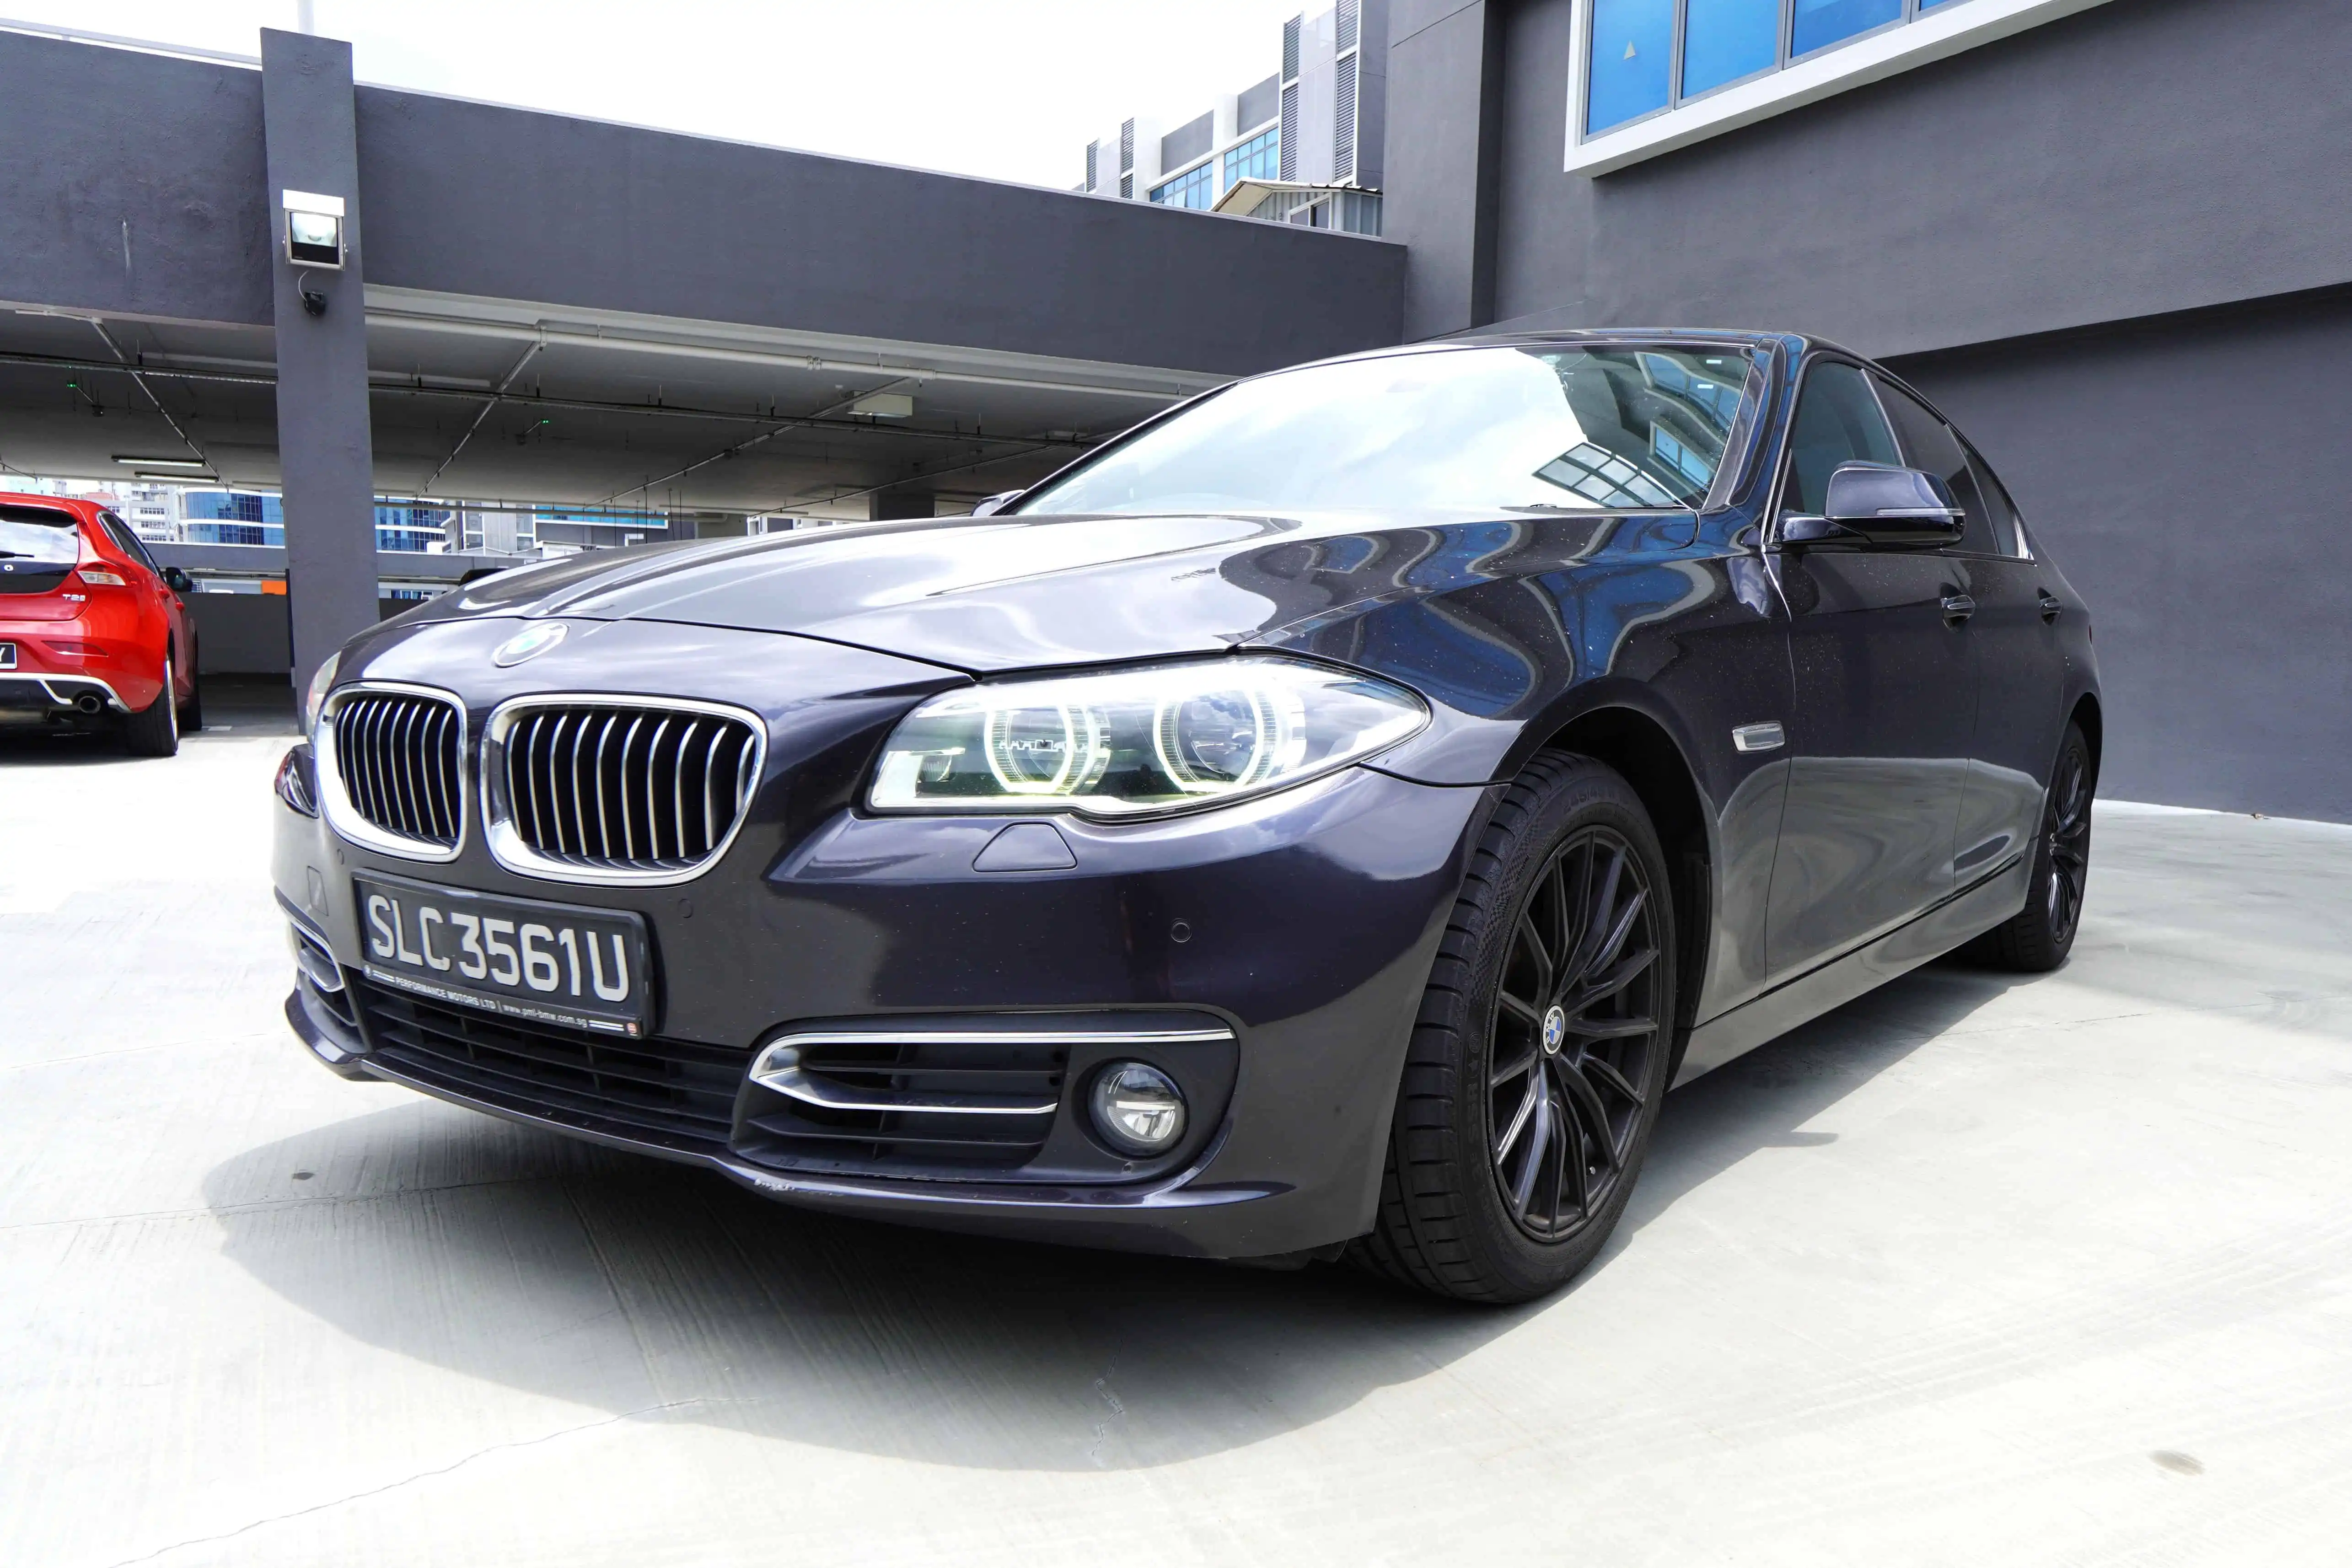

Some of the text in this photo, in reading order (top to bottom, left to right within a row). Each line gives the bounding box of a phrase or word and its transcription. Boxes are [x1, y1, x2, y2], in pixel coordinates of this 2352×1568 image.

[368, 895, 629, 1002] SLC3561U
[395, 977, 447, 998] PERFORMANCE
[446, 991, 479, 1006] MOTORS
[480, 999, 496, 1009] LTD
